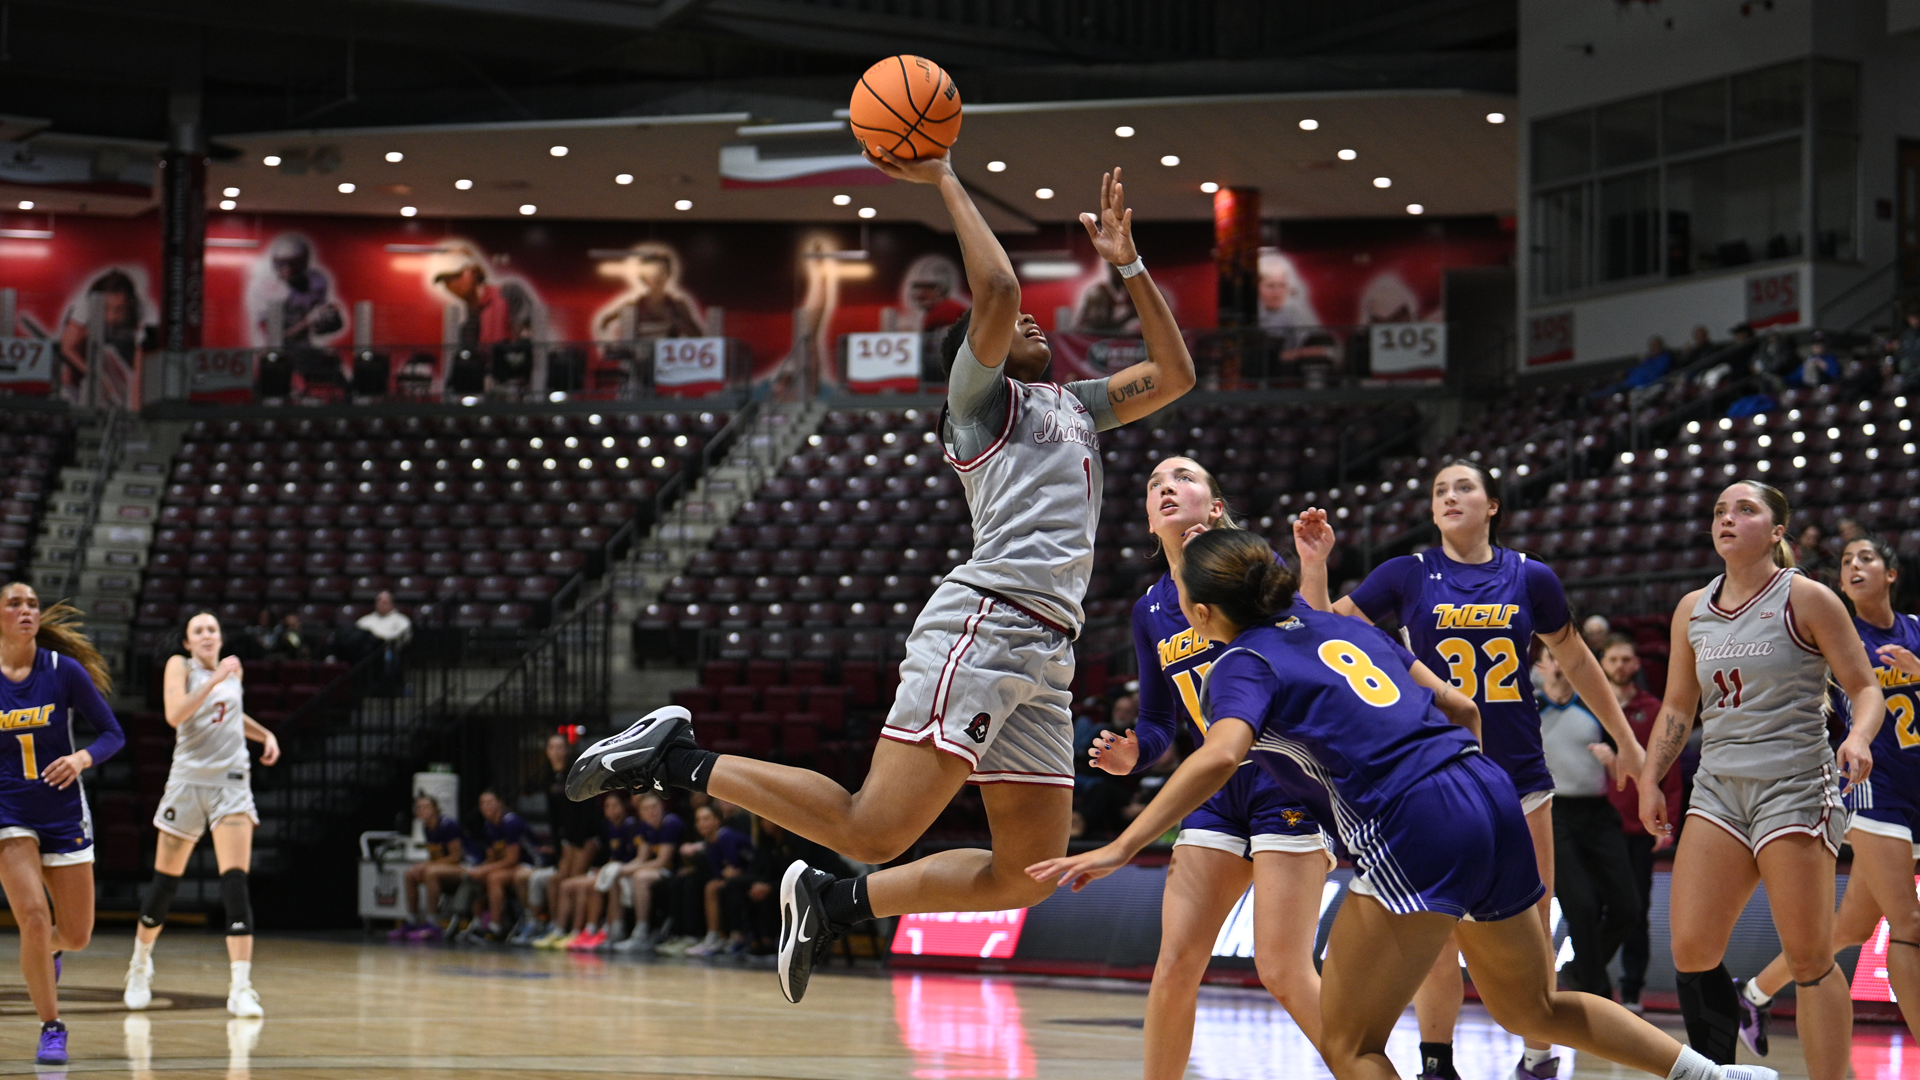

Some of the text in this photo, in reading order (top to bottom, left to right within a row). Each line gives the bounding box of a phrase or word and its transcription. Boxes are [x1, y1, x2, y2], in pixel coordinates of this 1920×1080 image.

[1752, 274, 1794, 306] 105
[663, 342, 717, 369] 106
[857, 338, 911, 365] 105
[1380, 327, 1437, 357] 105
[198, 350, 247, 377] 106
[1033, 410, 1100, 452] Indian
[1082, 456, 1091, 504] 1
[1432, 603, 1519, 630] WCU
[1695, 633, 1775, 664] Indiana
[1317, 639, 1401, 708] 8
[1435, 637, 1523, 703] 32
[1171, 661, 1212, 738] 1
[1711, 667, 1743, 709] 11
[0, 704, 56, 732] WCU
[212, 701, 226, 724] 3
[1884, 692, 1920, 750] 2
[15, 732, 39, 780] 1
